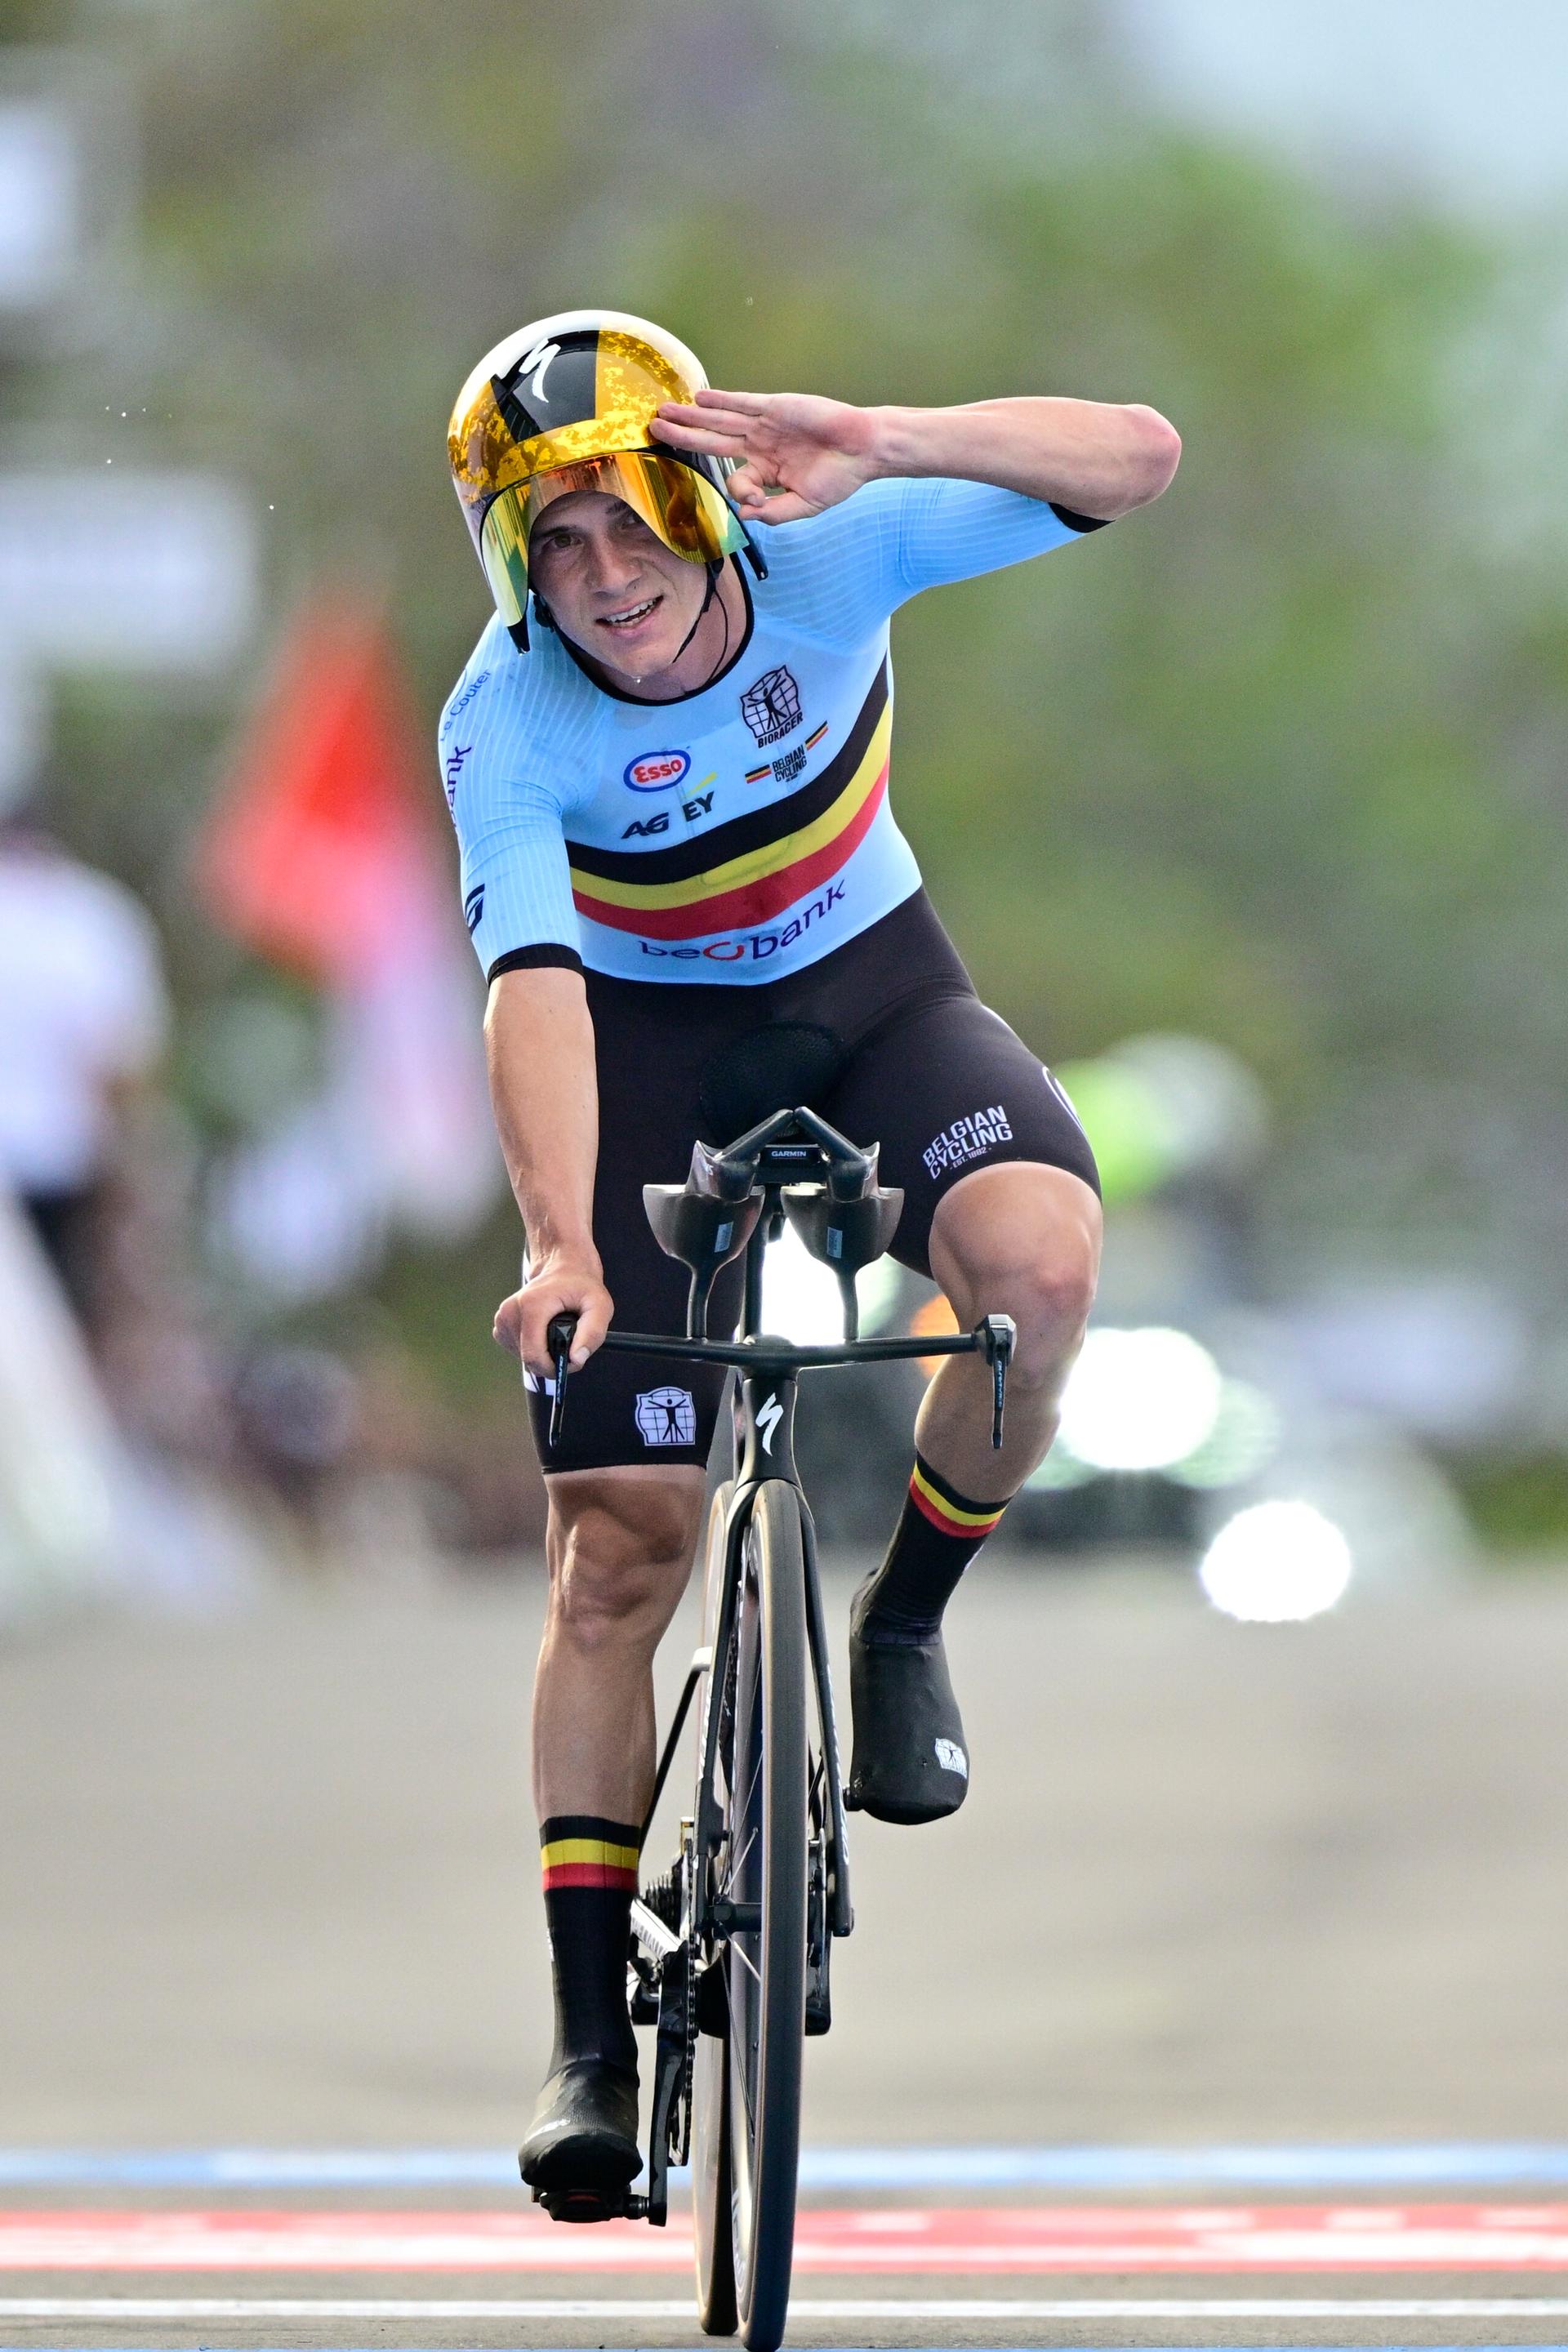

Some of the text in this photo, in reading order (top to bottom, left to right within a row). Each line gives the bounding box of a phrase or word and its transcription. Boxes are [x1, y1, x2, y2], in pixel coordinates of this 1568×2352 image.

[757, 711, 803, 749] BIORACER
[772, 744, 805, 772] BELGIAN
[774, 755, 807, 782] CYCLING
[621, 791, 715, 839] AG EY
[923, 1105, 1008, 1168] BELGIAN
[930, 1123, 1013, 1179] CYCLING
